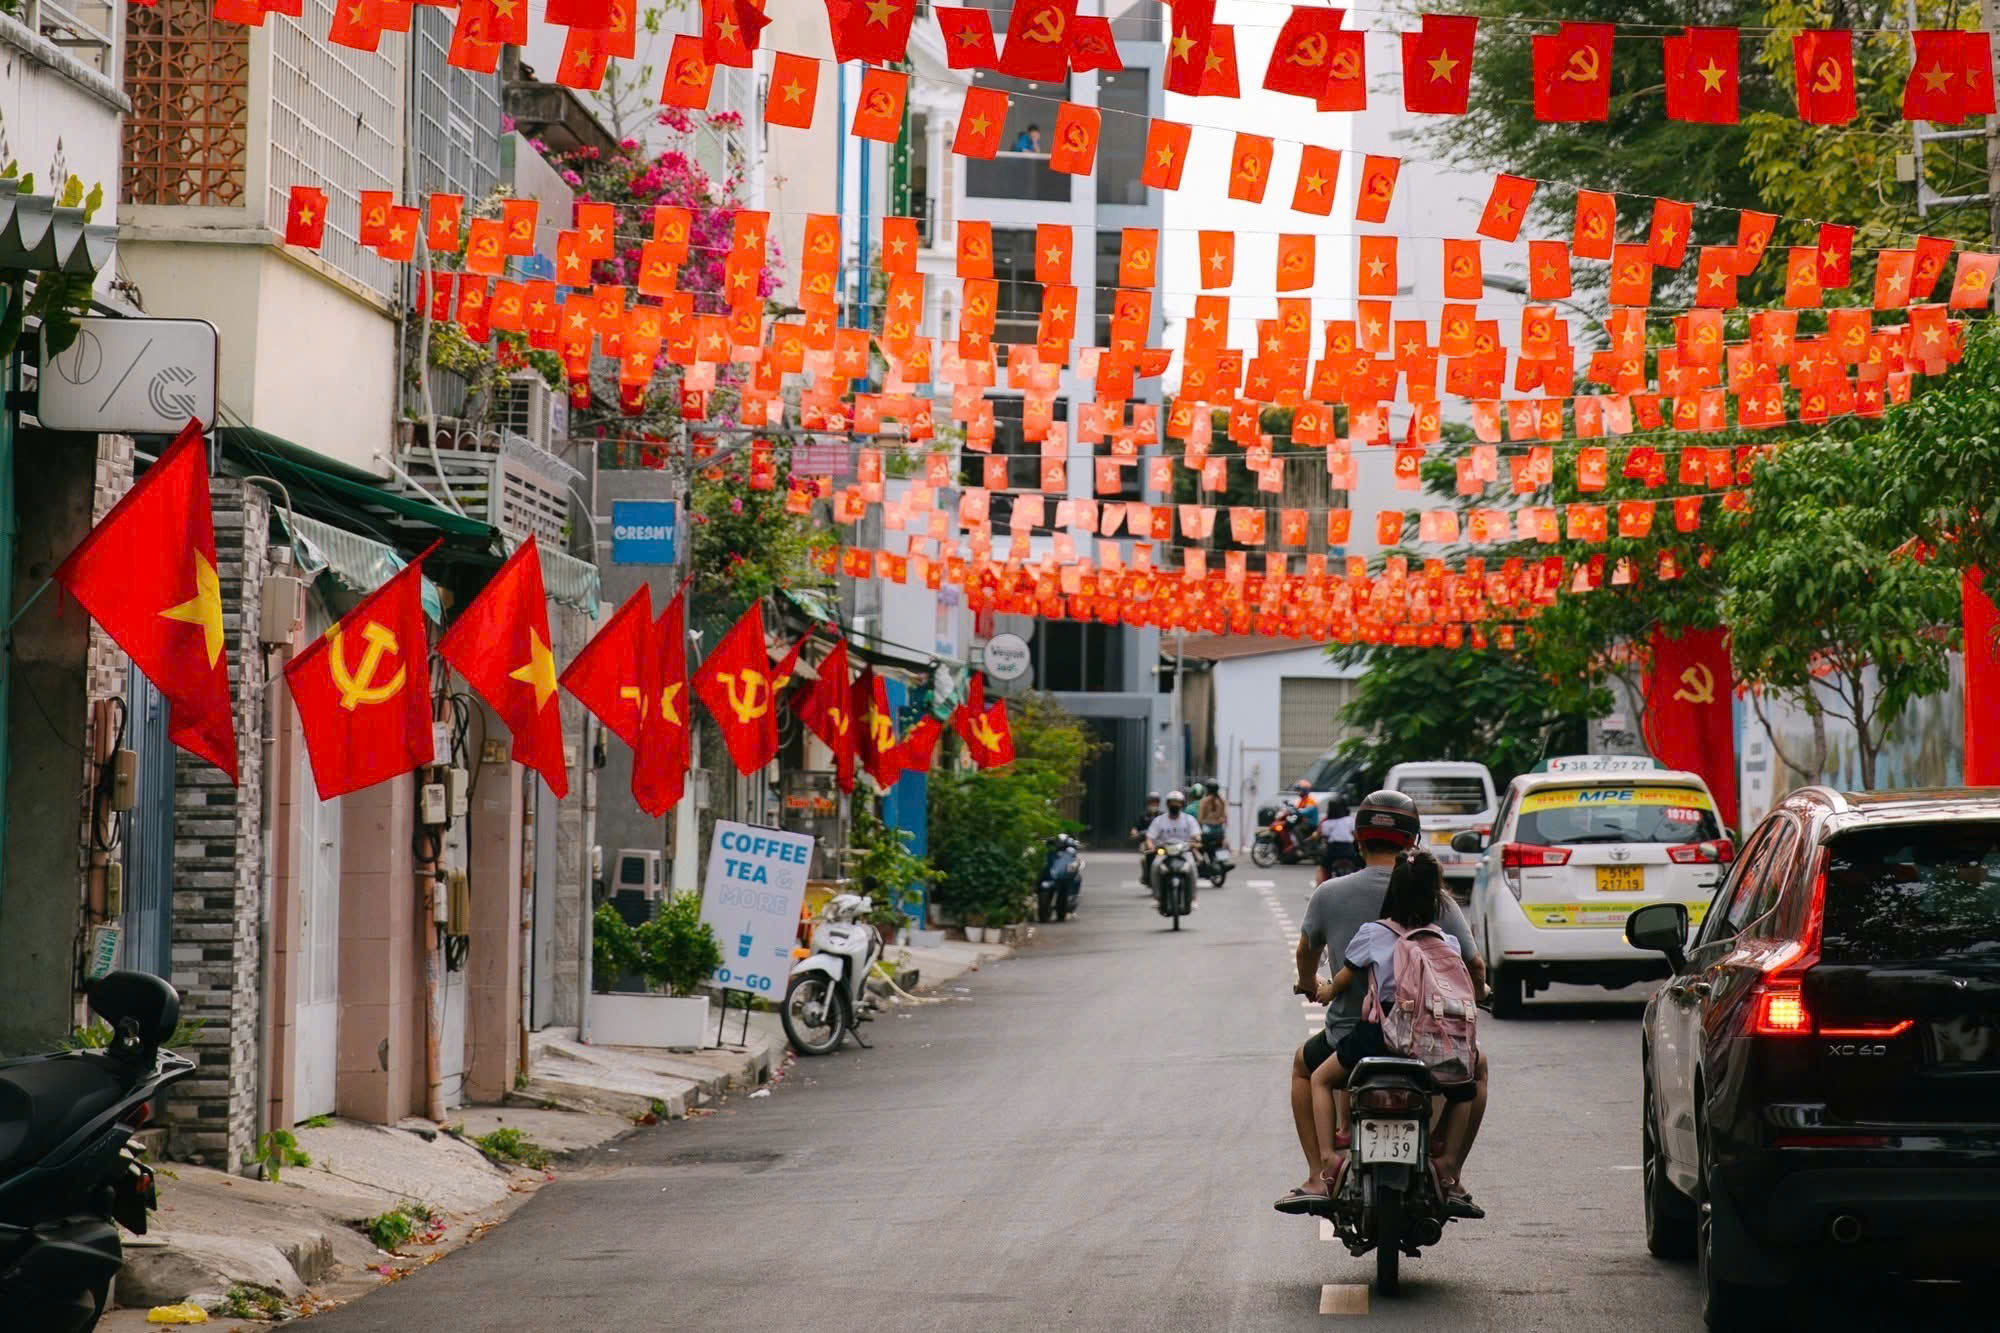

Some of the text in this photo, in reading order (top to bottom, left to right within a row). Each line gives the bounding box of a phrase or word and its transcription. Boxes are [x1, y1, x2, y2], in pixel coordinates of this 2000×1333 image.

[1592, 761, 1607, 770] 27
[1578, 790, 1635, 802] MPE
[720, 831, 808, 865] COFFEE
[725, 858, 794, 890] TEA &
[719, 884, 789, 916] MORE
